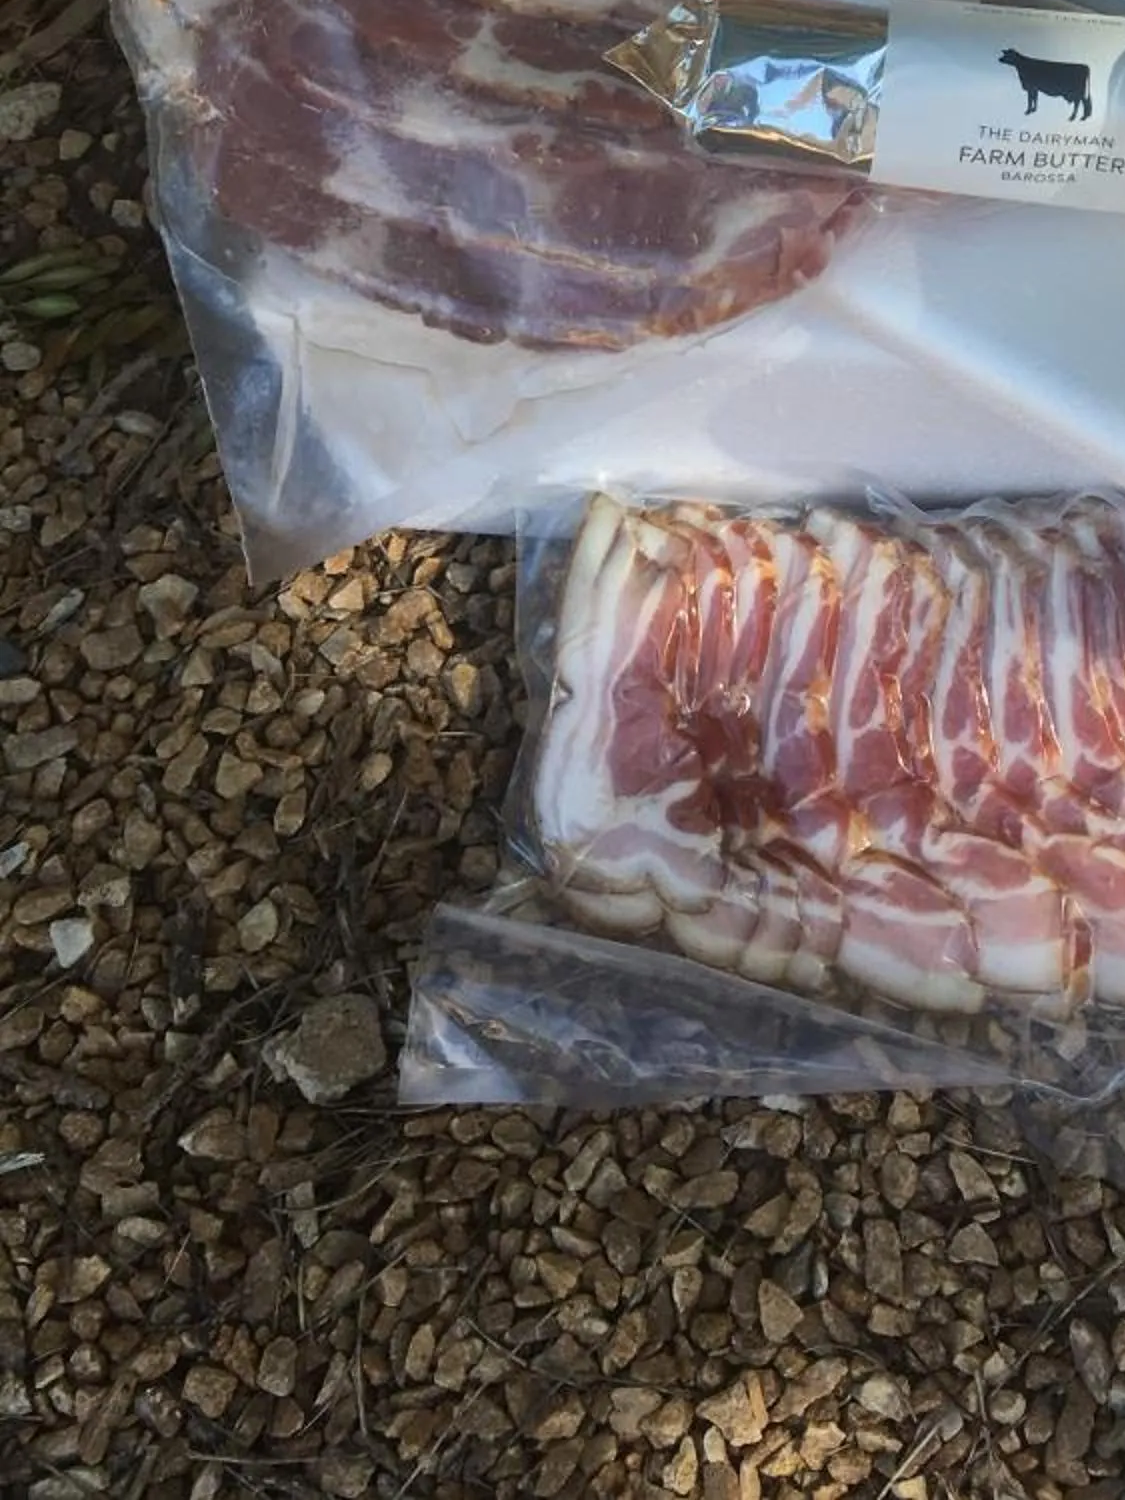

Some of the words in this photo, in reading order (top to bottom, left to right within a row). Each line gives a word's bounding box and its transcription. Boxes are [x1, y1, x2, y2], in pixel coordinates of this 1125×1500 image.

[979, 125, 1012, 141] THE
[1018, 130, 1116, 150] DAIRYMAN
[958, 146, 1026, 168] FARM
[1032, 150, 1125, 174] BUTTER
[1000, 170, 1077, 184] BAROSSA
